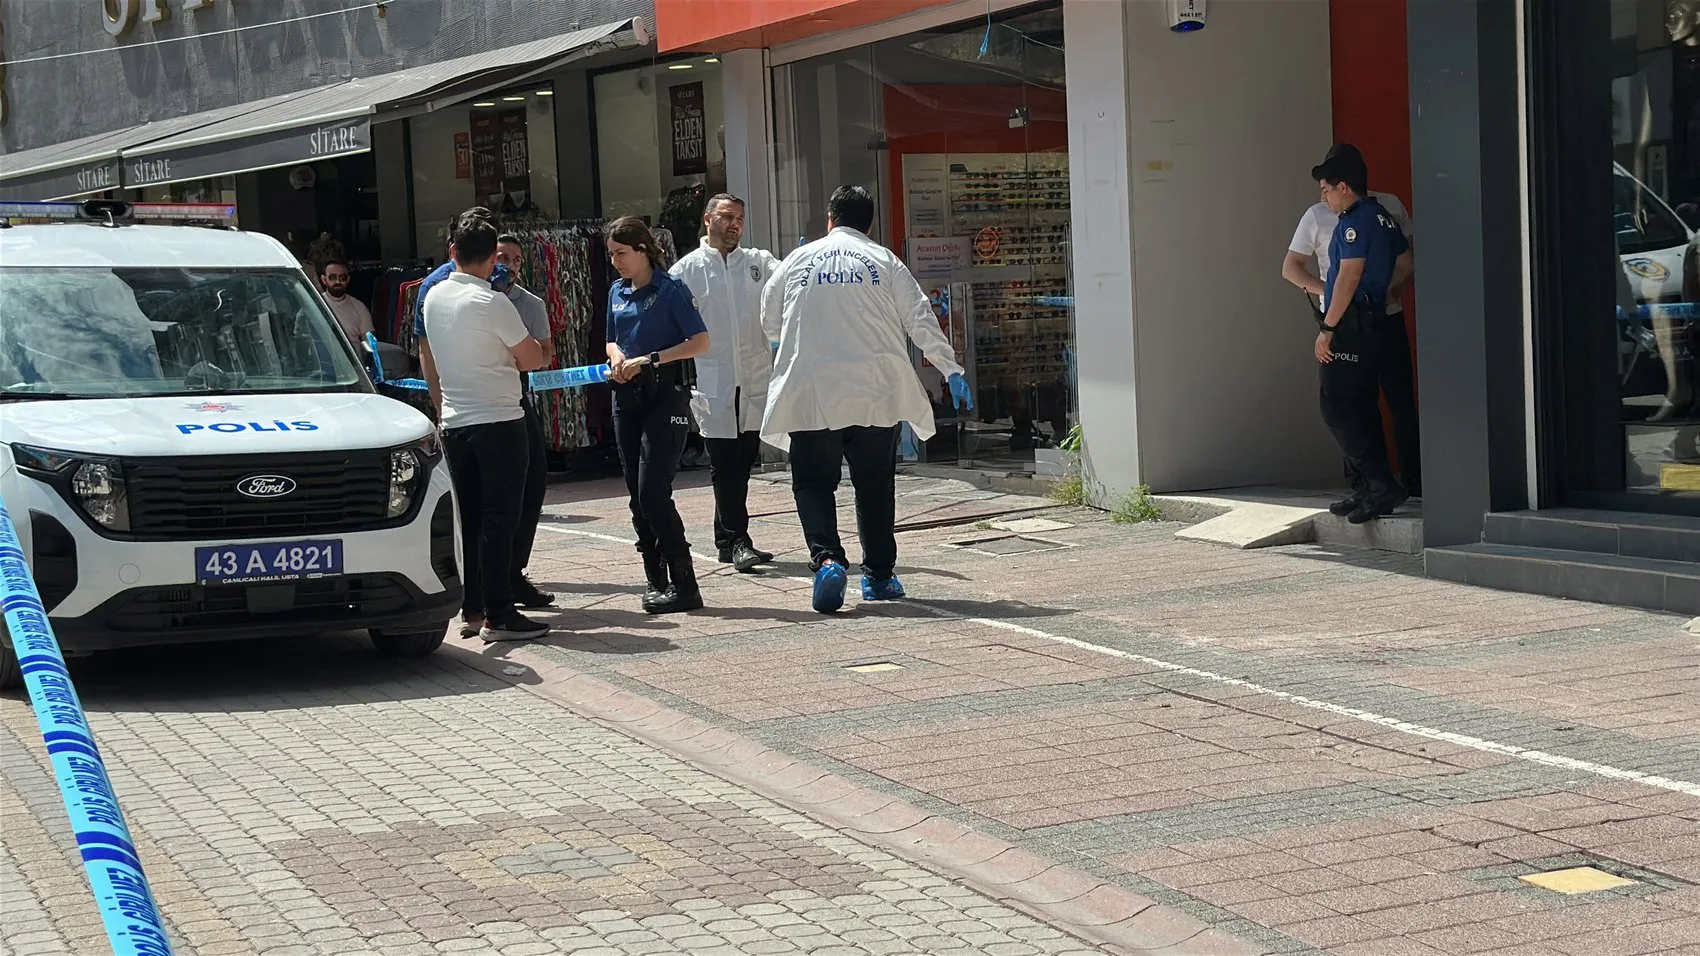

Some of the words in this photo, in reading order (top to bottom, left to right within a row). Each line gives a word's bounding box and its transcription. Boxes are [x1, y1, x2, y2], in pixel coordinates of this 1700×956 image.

[310, 126, 357, 154] SİTARE
[674, 117, 702, 141] ELDEN
[77, 166, 110, 190] SİTARE
[134, 158, 171, 183] SİTARE
[801, 261, 815, 287] OLAY
[844, 249, 880, 286] İNCELEME
[818, 269, 863, 285] POLİS
[176, 420, 319, 434] POLİS
[248, 478, 285, 493] Ford
[205, 552, 238, 575] 43
[245, 550, 267, 573] A
[273, 545, 333, 571] 4821
[73, 796, 124, 830] POLİS
